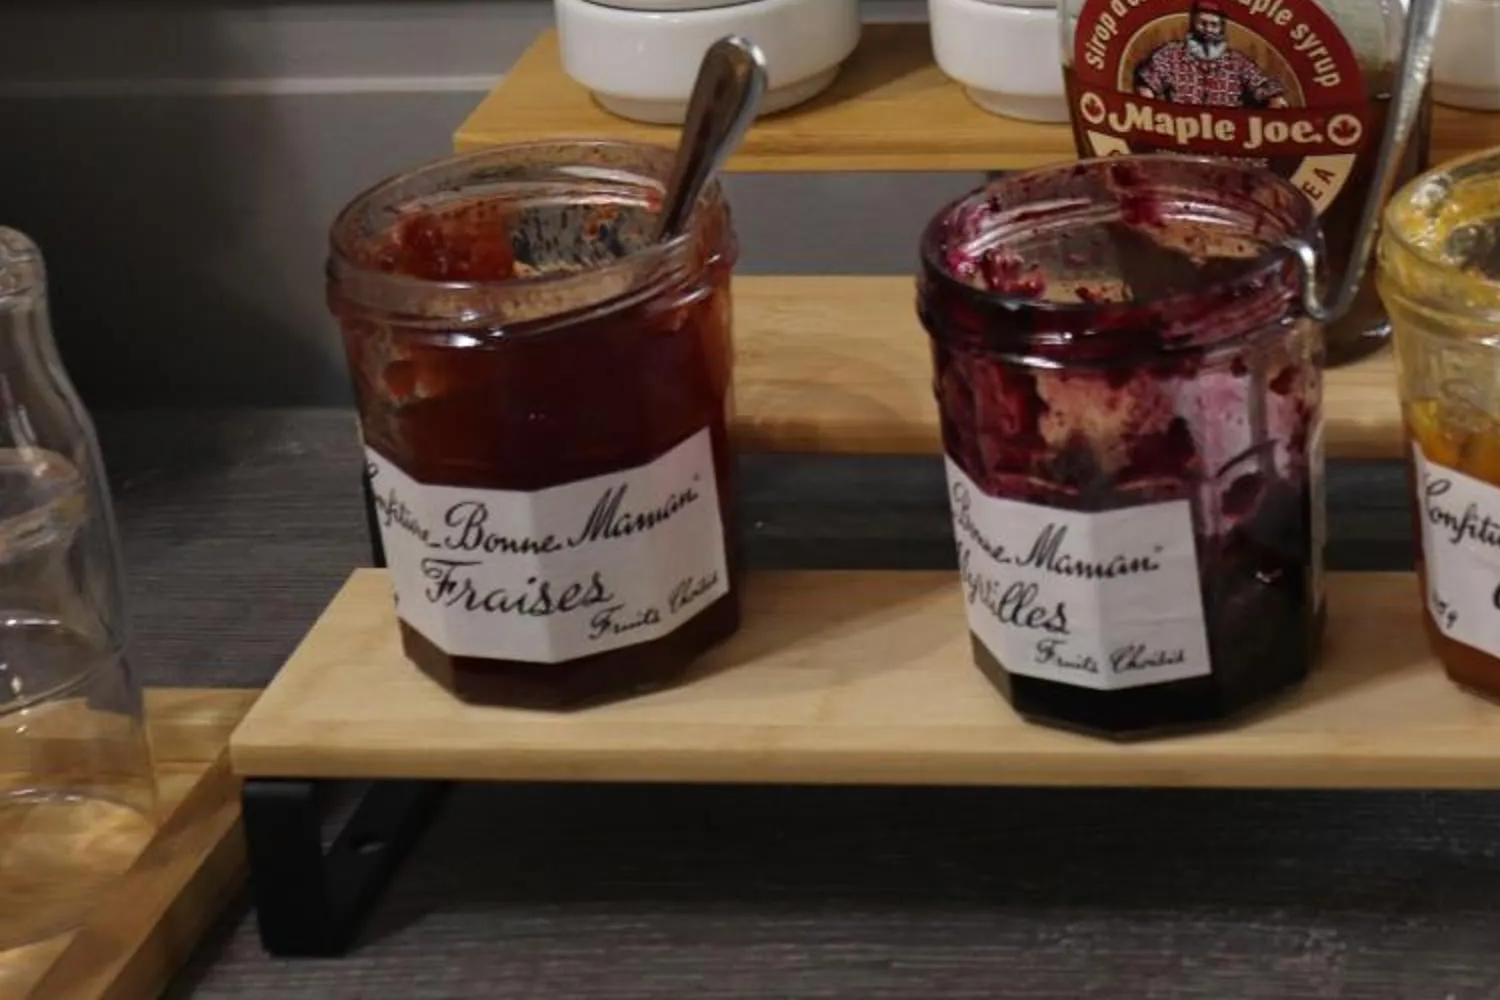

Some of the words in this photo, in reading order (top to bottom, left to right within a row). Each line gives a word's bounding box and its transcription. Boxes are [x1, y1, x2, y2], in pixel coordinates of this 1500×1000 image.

[1085, 11, 1118, 70] sirop
[1290, 22, 1341, 88] syrup
[1108, 103, 1237, 145] Maple
[444, 501, 562, 553] Bonne
[567, 482, 699, 547] Maman
[1015, 522, 1160, 580] Maman
[421, 557, 615, 616] Fraises
